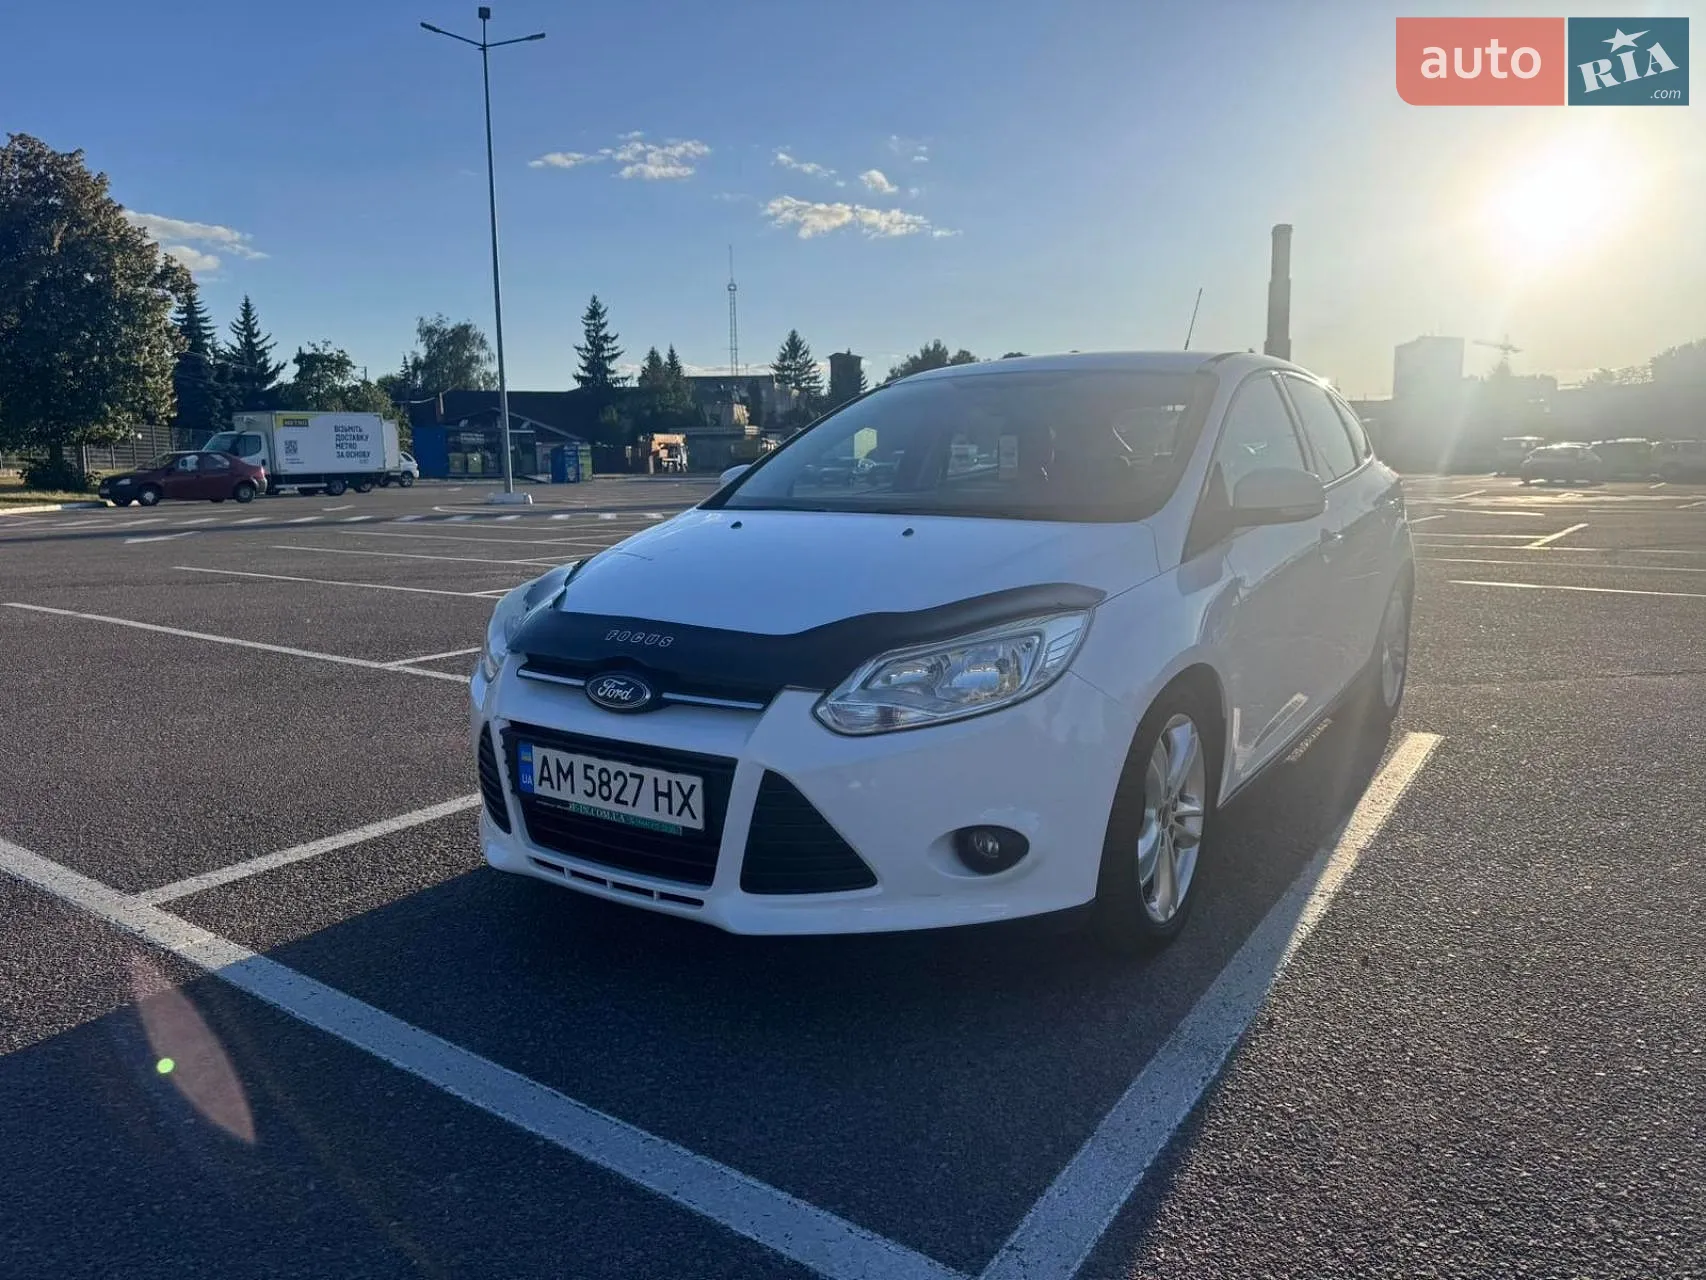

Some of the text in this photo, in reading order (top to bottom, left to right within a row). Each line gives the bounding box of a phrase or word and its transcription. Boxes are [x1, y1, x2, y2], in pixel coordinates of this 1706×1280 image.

[335, 434, 369, 442] ДОСТАВКУ
[604, 629, 675, 647] FOCUS
[598, 679, 634, 700] Ford
[521, 773, 533, 785] UA
[538, 754, 698, 820] AM 5827 HX
